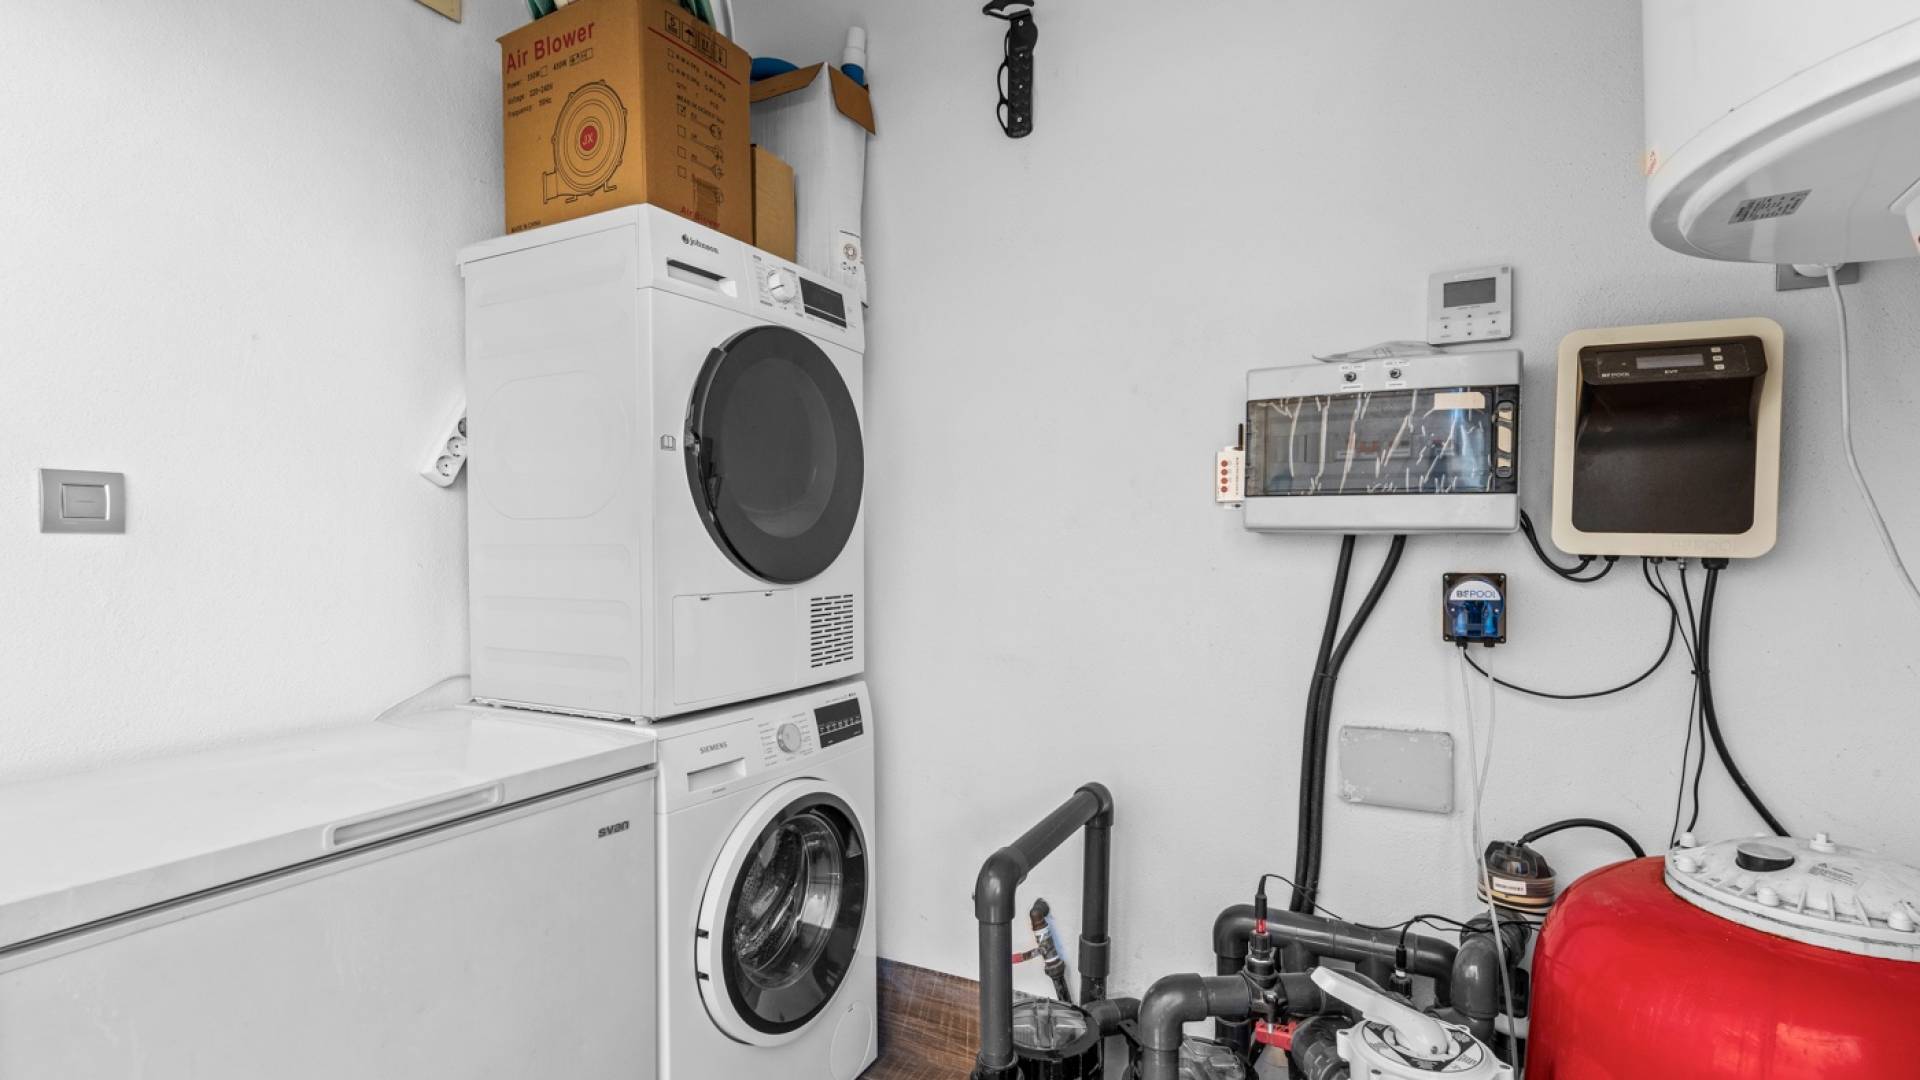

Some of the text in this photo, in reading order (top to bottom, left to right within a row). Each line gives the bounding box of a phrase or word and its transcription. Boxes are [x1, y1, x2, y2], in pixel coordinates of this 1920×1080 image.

[506, 22, 595, 74] Air Blower
[583, 132, 594, 145] JX
[699, 741, 728, 754] SIEMENS
[598, 820, 630, 839] svan
